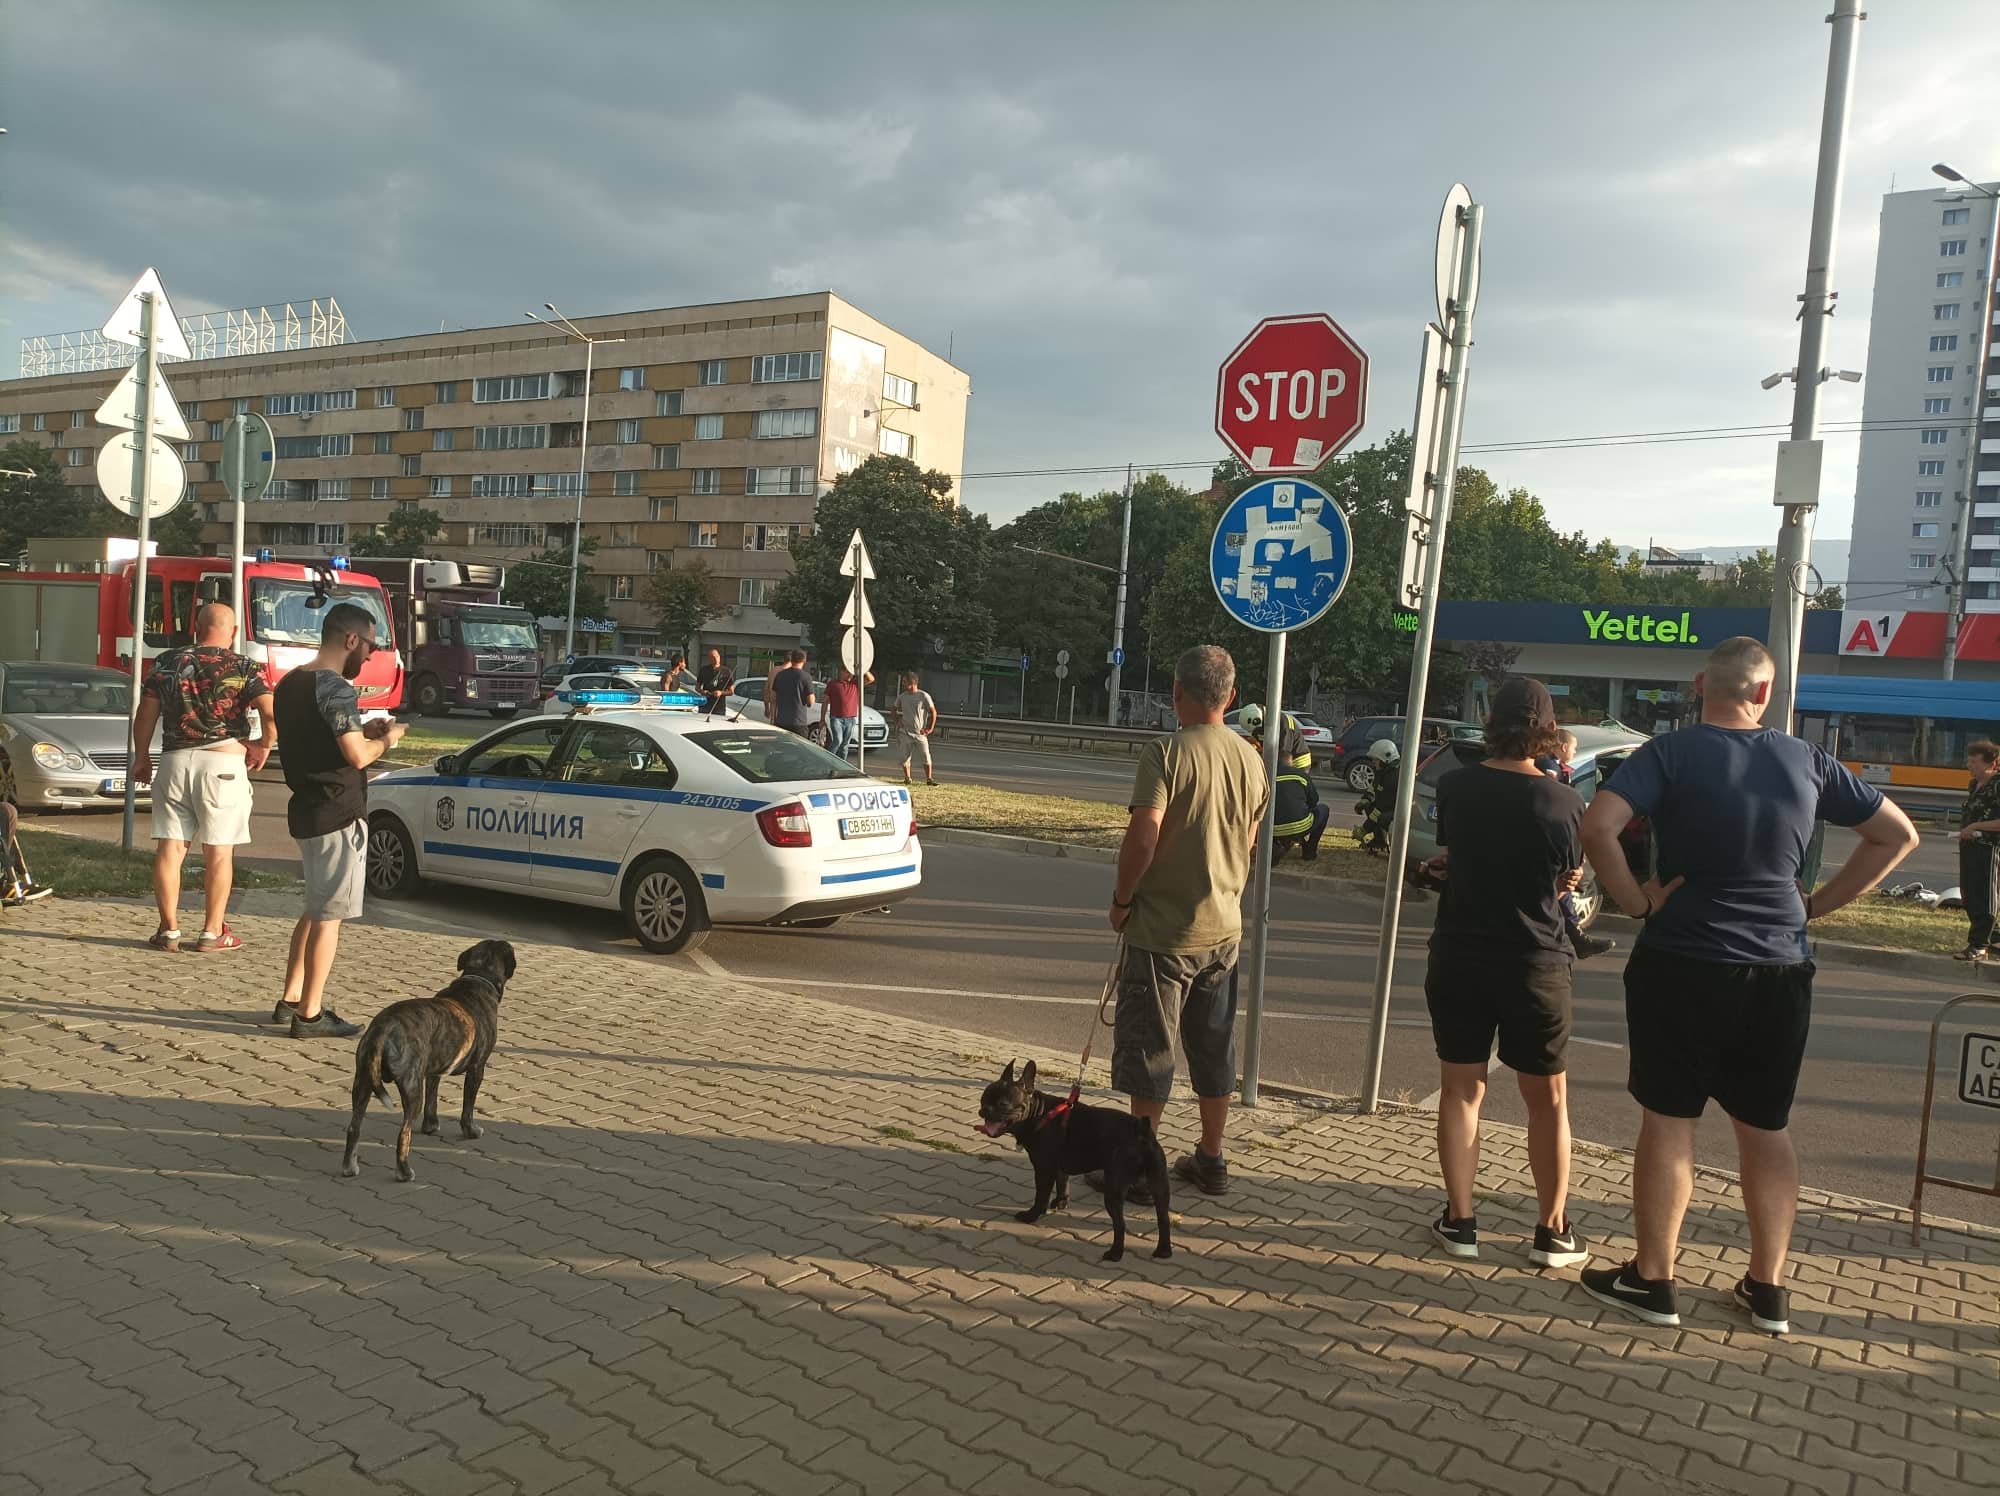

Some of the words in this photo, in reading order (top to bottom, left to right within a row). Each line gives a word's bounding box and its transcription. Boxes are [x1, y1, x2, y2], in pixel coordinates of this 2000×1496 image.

[1235, 368, 1346, 422] STOP
[1393, 612, 1419, 631] Yette
[1582, 610, 1699, 643] Yettel.
[1845, 615, 1890, 652] A1
[681, 793, 742, 810] 24-0105
[833, 790, 900, 811] POLICE
[466, 806, 584, 840] ПОЛИЦИЯ
[848, 820, 860, 834] CB
[861, 819, 880, 832] 8591
[1981, 1045, 2000, 1068] С
